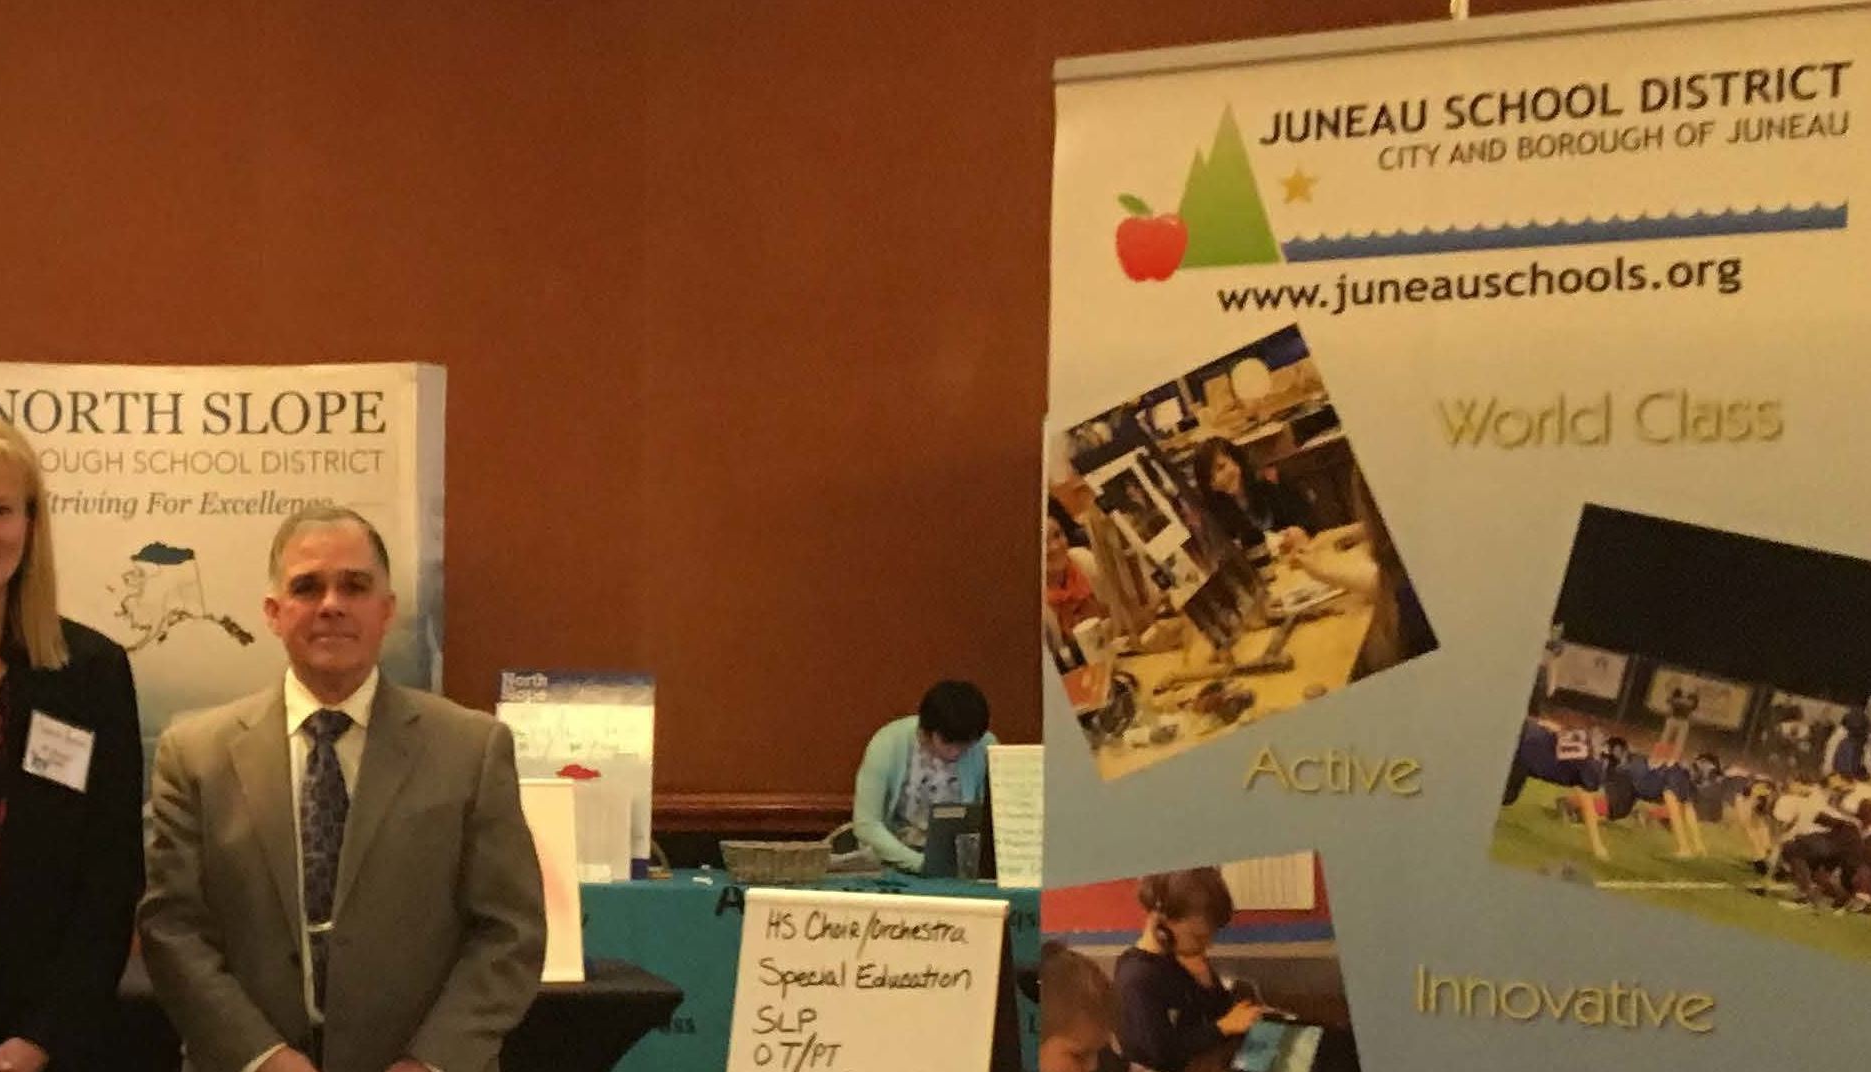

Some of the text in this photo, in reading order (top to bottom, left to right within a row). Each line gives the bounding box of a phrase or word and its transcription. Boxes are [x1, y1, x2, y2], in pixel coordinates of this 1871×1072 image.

[1259, 62, 1853, 146] JUNEAU SCHOOL DISTRICT
[1379, 110, 1849, 171] CITY AND BOROUGH OF JUNEAU
[1218, 255, 1743, 315] www.juneauschools.org
[202, 391, 386, 435] SLOPE
[1437, 389, 1784, 451] World Class
[38, 448, 386, 475] OUGH SCHOOL DISTRICT
[48, 490, 138, 518] triving
[146, 492, 193, 516] For
[1243, 745, 1422, 795] Active
[766, 908, 797, 940] HS
[759, 957, 972, 999] Special Education
[1415, 964, 1715, 1033] Innovative
[752, 1004, 818, 1034] SLP
